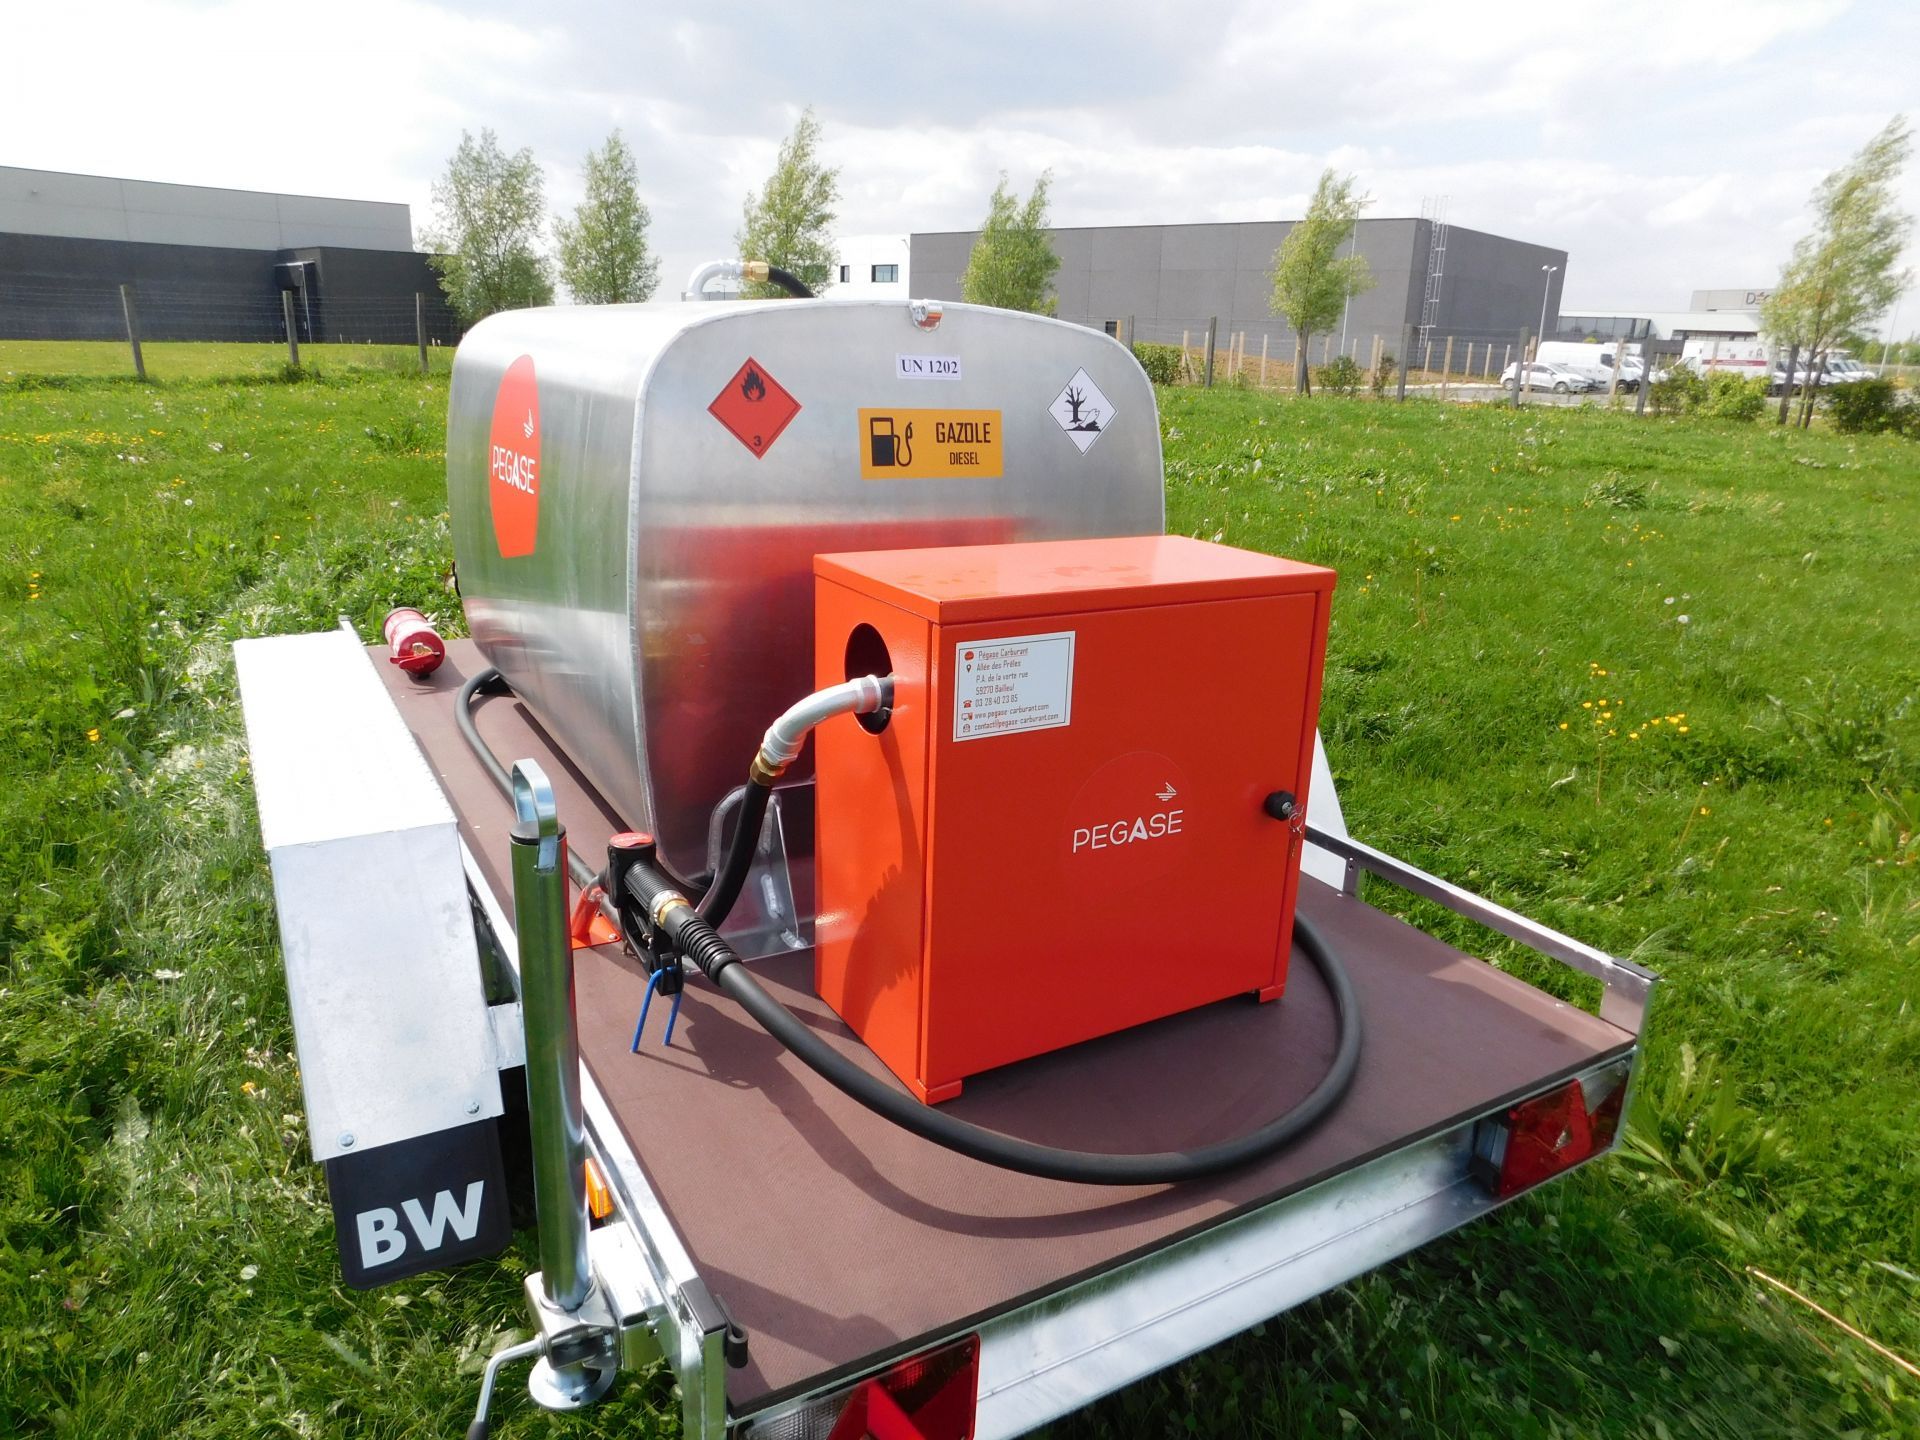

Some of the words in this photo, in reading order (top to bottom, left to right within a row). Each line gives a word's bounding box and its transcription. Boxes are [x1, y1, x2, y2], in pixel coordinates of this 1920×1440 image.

[900, 358, 924, 374] UN
[928, 360, 959, 375] 1202
[935, 421, 992, 444] GAZOLE
[752, 435, 763, 448] 3
[948, 451, 981, 466] DIESEL
[492, 445, 535, 495] PEGASE
[979, 650, 999, 660] Pégase
[1000, 647, 1029, 656] Carburant
[976, 663, 990, 671] Allée
[992, 661, 1002, 669] des
[988, 673, 995, 682] de
[996, 673, 1002, 681] la
[975, 685, 994, 695] 59270
[995, 684, 1014, 693] Bailleul
[975, 698, 983, 708] 03
[985, 697, 992, 706] 28
[993, 696, 1001, 705] 40
[1002, 695, 1010, 704] 23
[1072, 809, 1184, 854] PEGASE
[356, 1180, 485, 1270] BW
